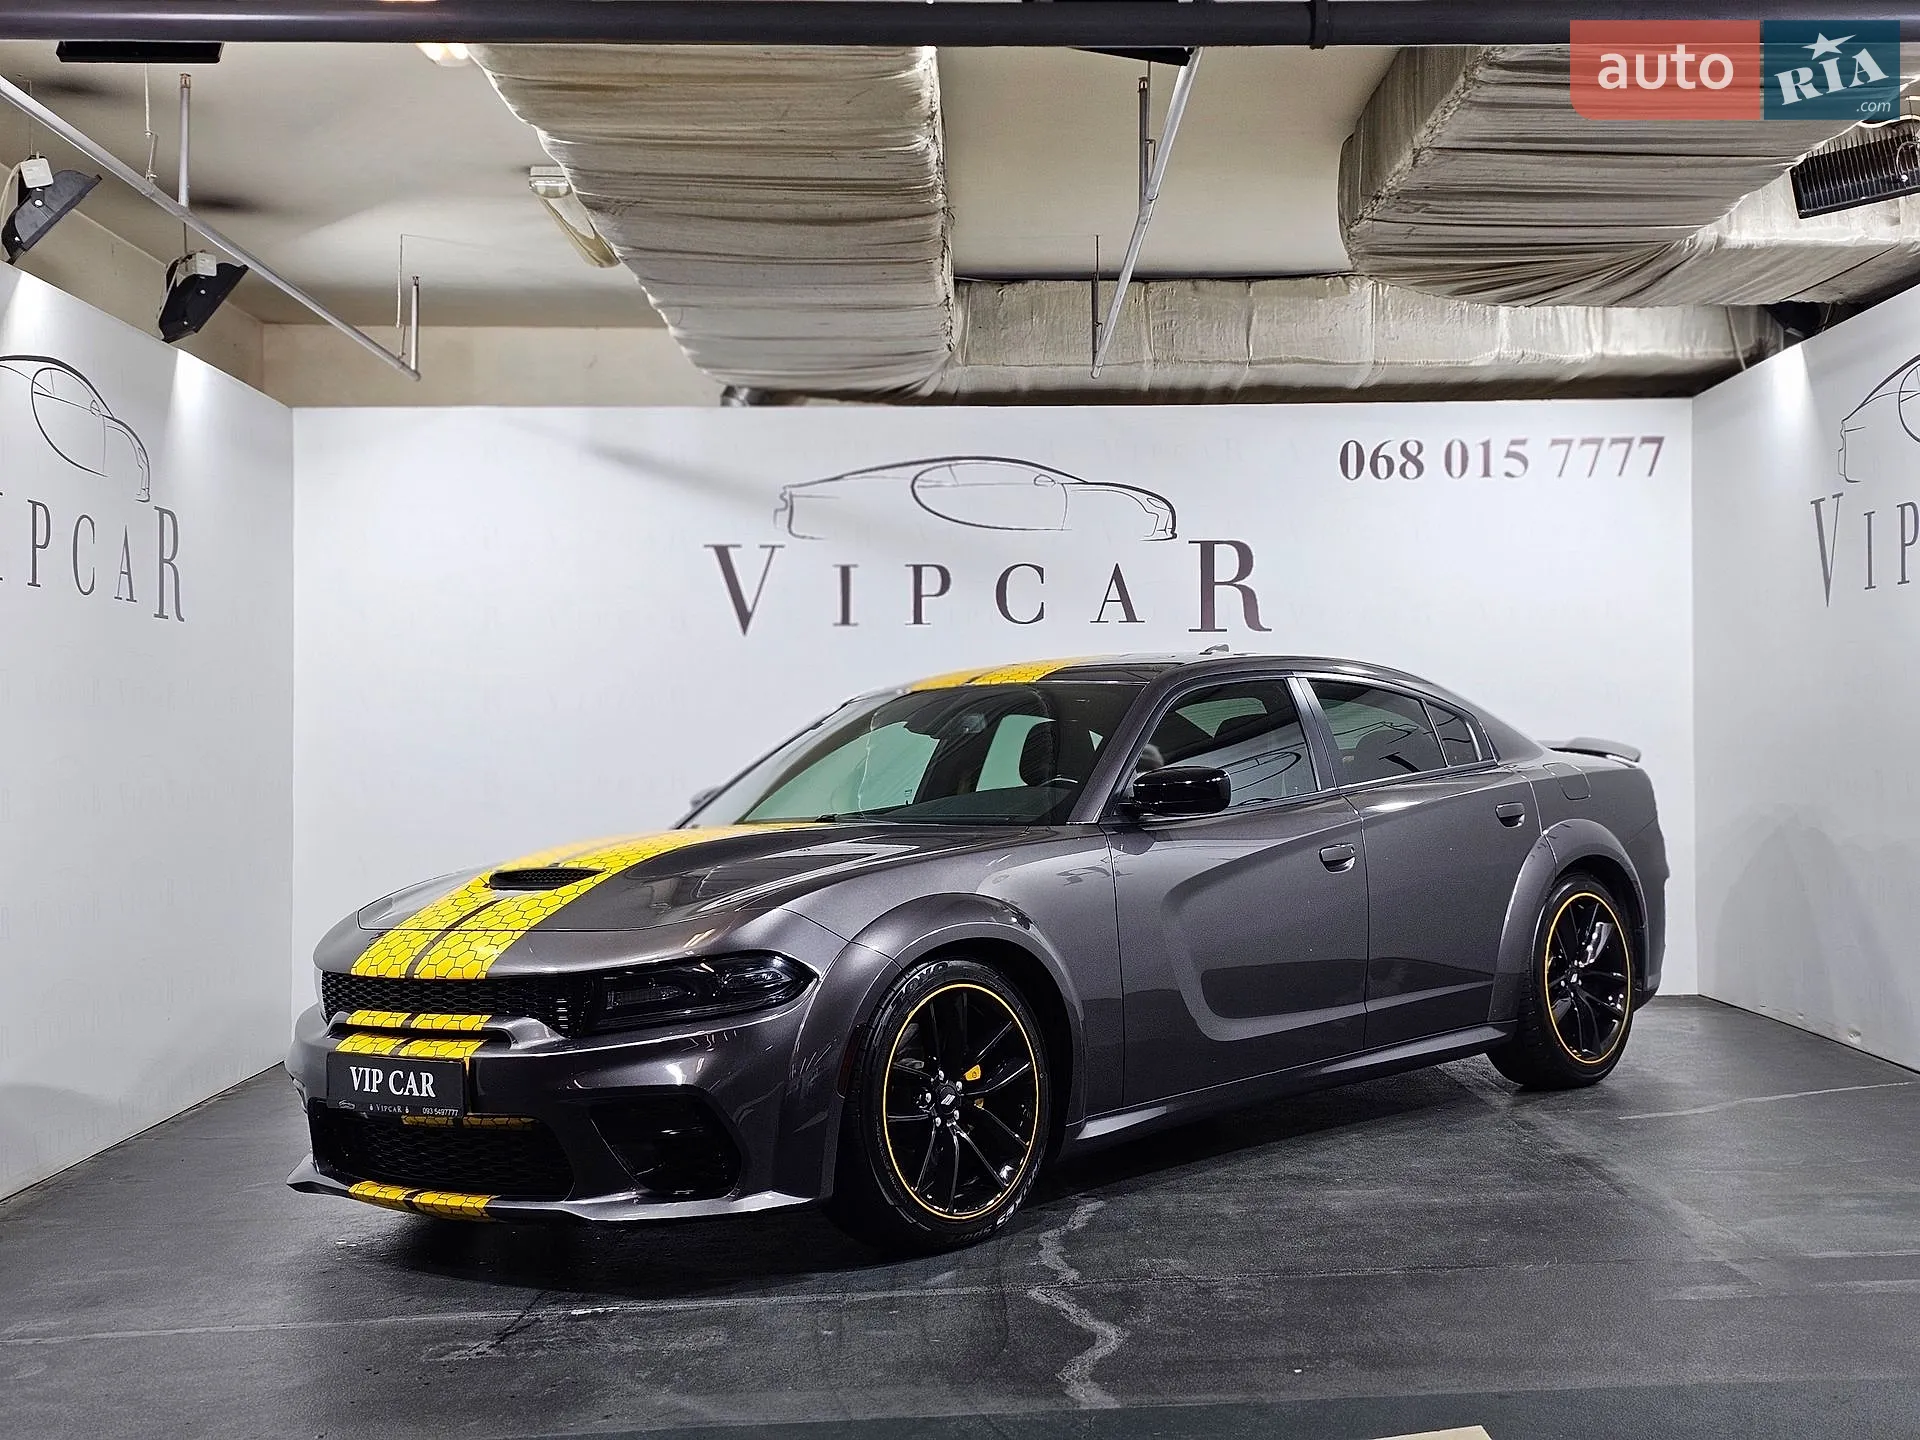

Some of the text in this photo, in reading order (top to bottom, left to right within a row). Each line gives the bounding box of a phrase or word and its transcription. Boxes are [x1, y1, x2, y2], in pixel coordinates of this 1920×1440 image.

[1339, 436, 1666, 480] 068 015 7777
[0, 490, 185, 622] PCAR
[703, 539, 1273, 636] VIPCAR
[350, 1066, 436, 1098] VIP CAR
[422, 1107, 434, 1115] 093
